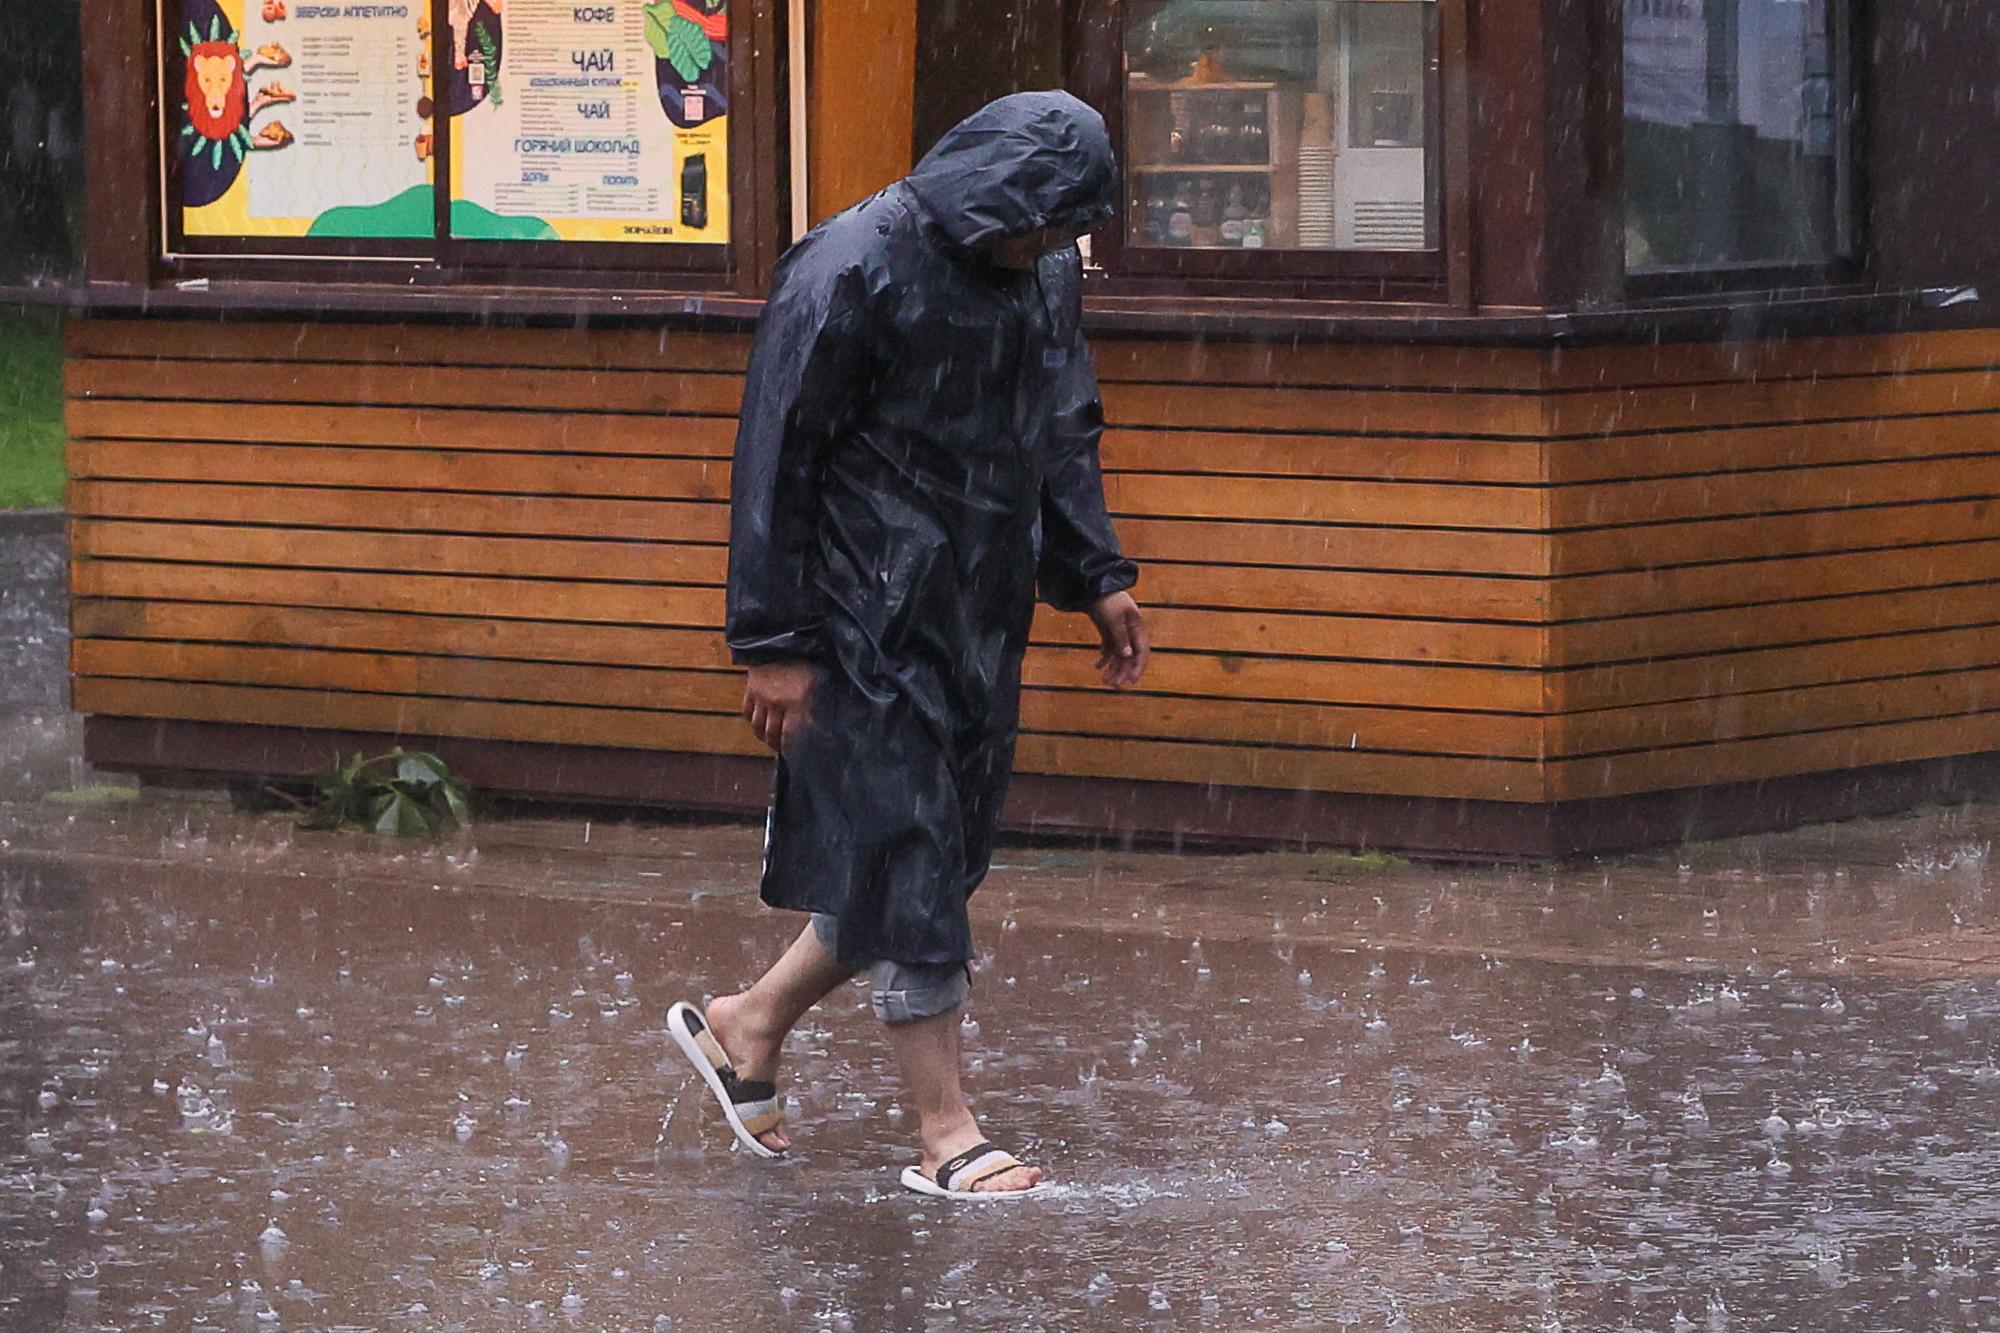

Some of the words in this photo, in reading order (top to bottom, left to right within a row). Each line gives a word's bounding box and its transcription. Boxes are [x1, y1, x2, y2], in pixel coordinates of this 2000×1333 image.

[343, 5, 408, 18] АППЕТИТНО
[573, 7, 615, 22] КОФЕ
[572, 48, 614, 72] ЧАЙ
[577, 100, 610, 119] ЧАЙ
[514, 138, 572, 153] ГОРЯЧИЙ
[574, 139, 640, 154] ШОКОЛАД
